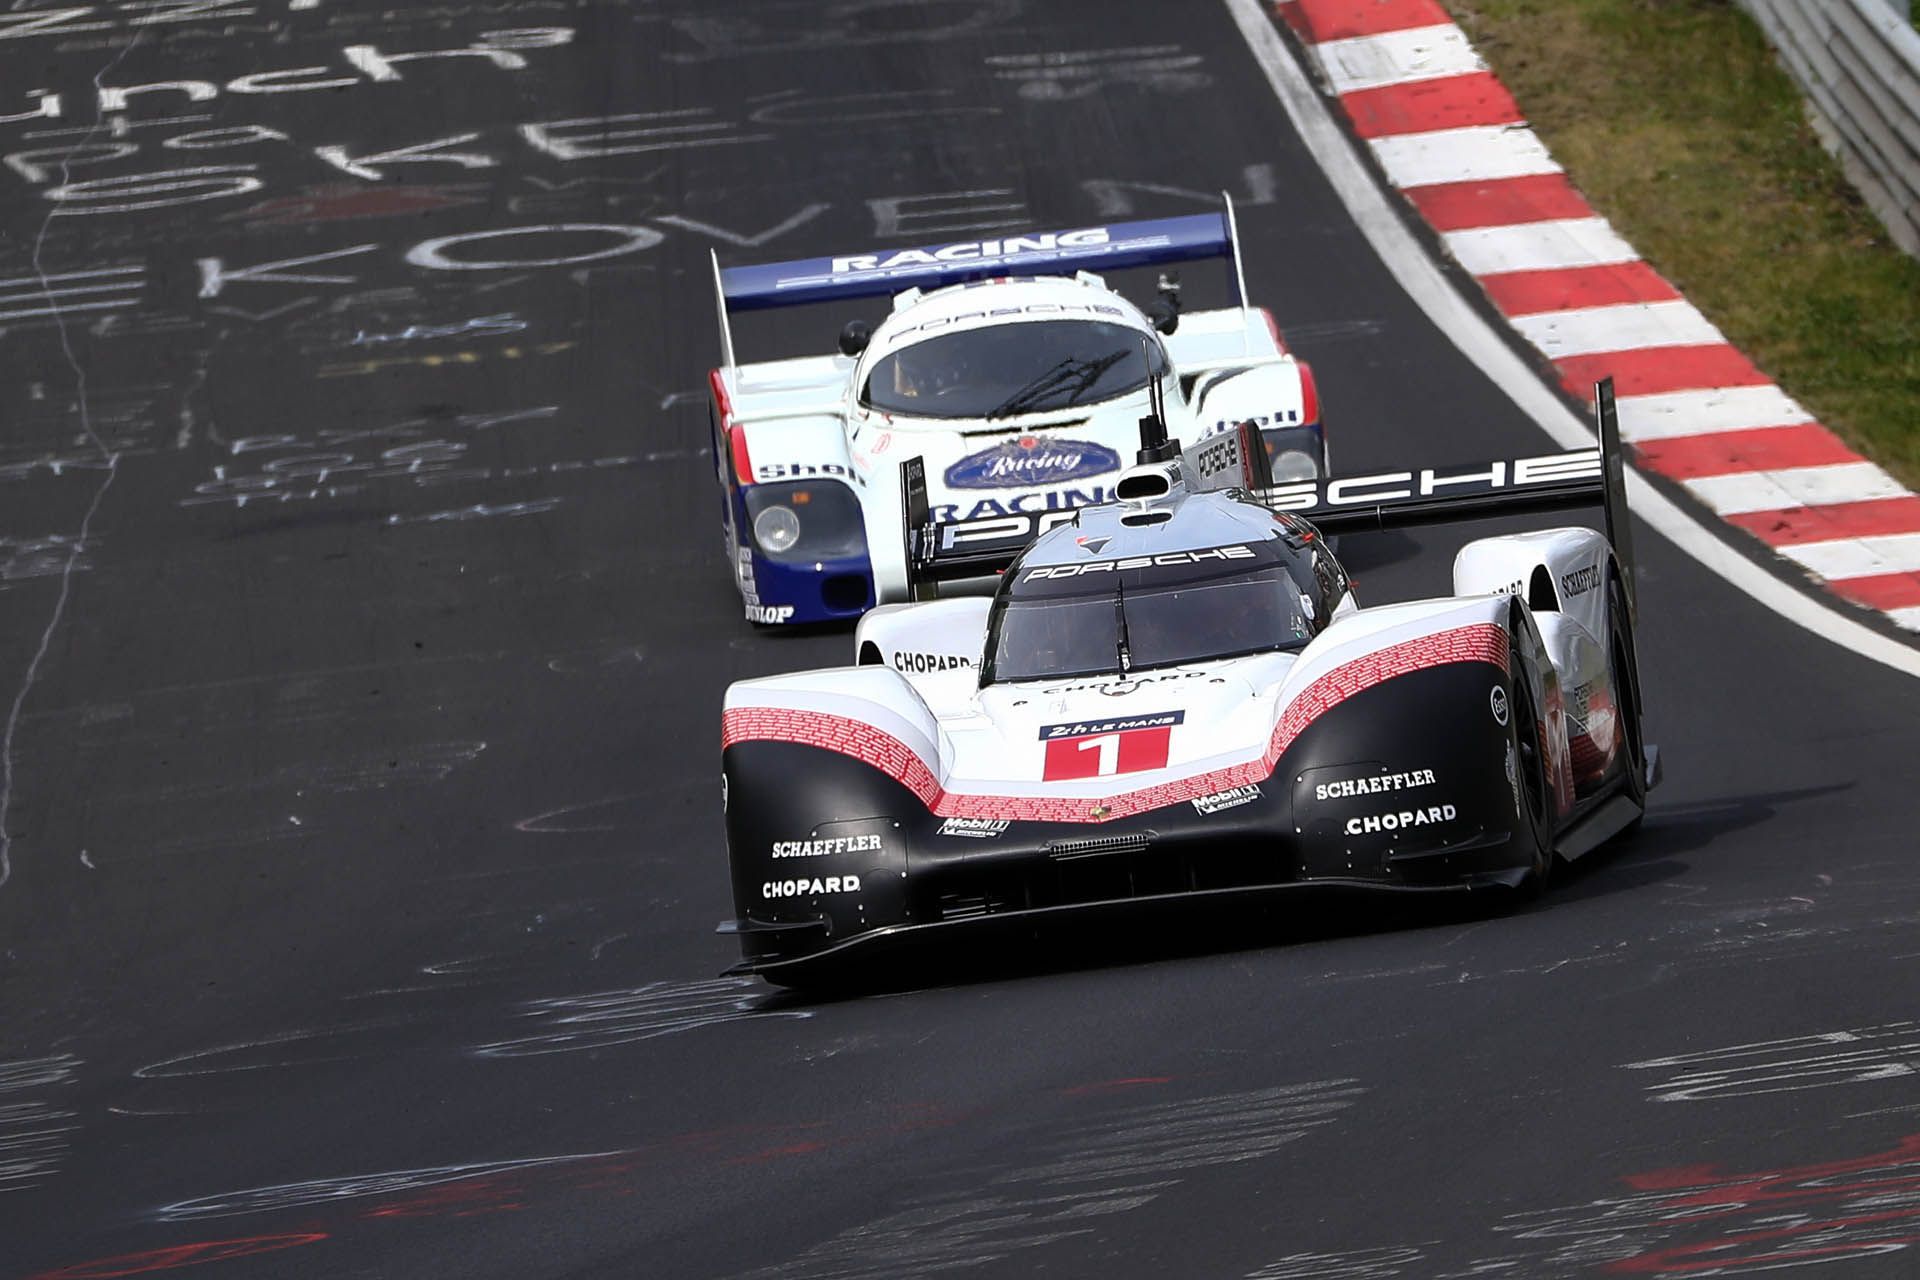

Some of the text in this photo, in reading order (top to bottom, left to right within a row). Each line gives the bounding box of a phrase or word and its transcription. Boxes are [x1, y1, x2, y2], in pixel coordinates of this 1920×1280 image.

[832, 228, 1110, 273] RACING
[1023, 545, 1257, 584] PORSCHE
[744, 604, 795, 625] DUNLOP
[1118, 716, 1176, 730] MANS
[1077, 733, 1121, 777] 1
[1316, 769, 1437, 800] SCHAEFFLER
[1191, 788, 1241, 808] Mobil
[943, 817, 992, 829] Mobil
[1346, 804, 1457, 835] CHOPARD
[772, 834, 882, 858] SCHAEFFLER
[762, 875, 860, 899] CHOPARD
